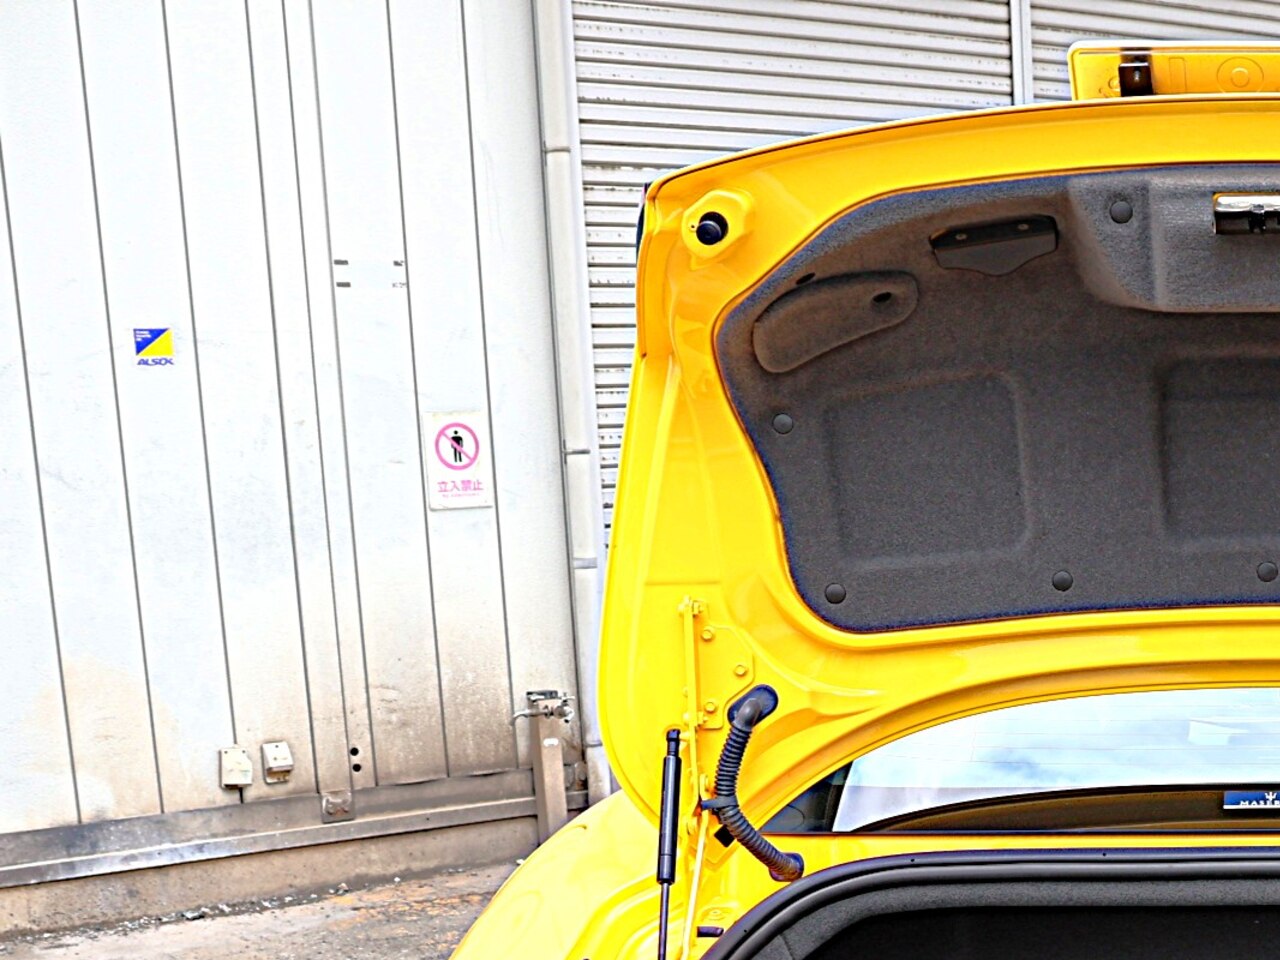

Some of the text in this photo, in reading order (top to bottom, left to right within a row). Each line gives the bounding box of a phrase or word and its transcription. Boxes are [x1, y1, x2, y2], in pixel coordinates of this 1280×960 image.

[137, 357, 174, 366] ALSOK
[437, 479, 485, 493] 立入禁止
